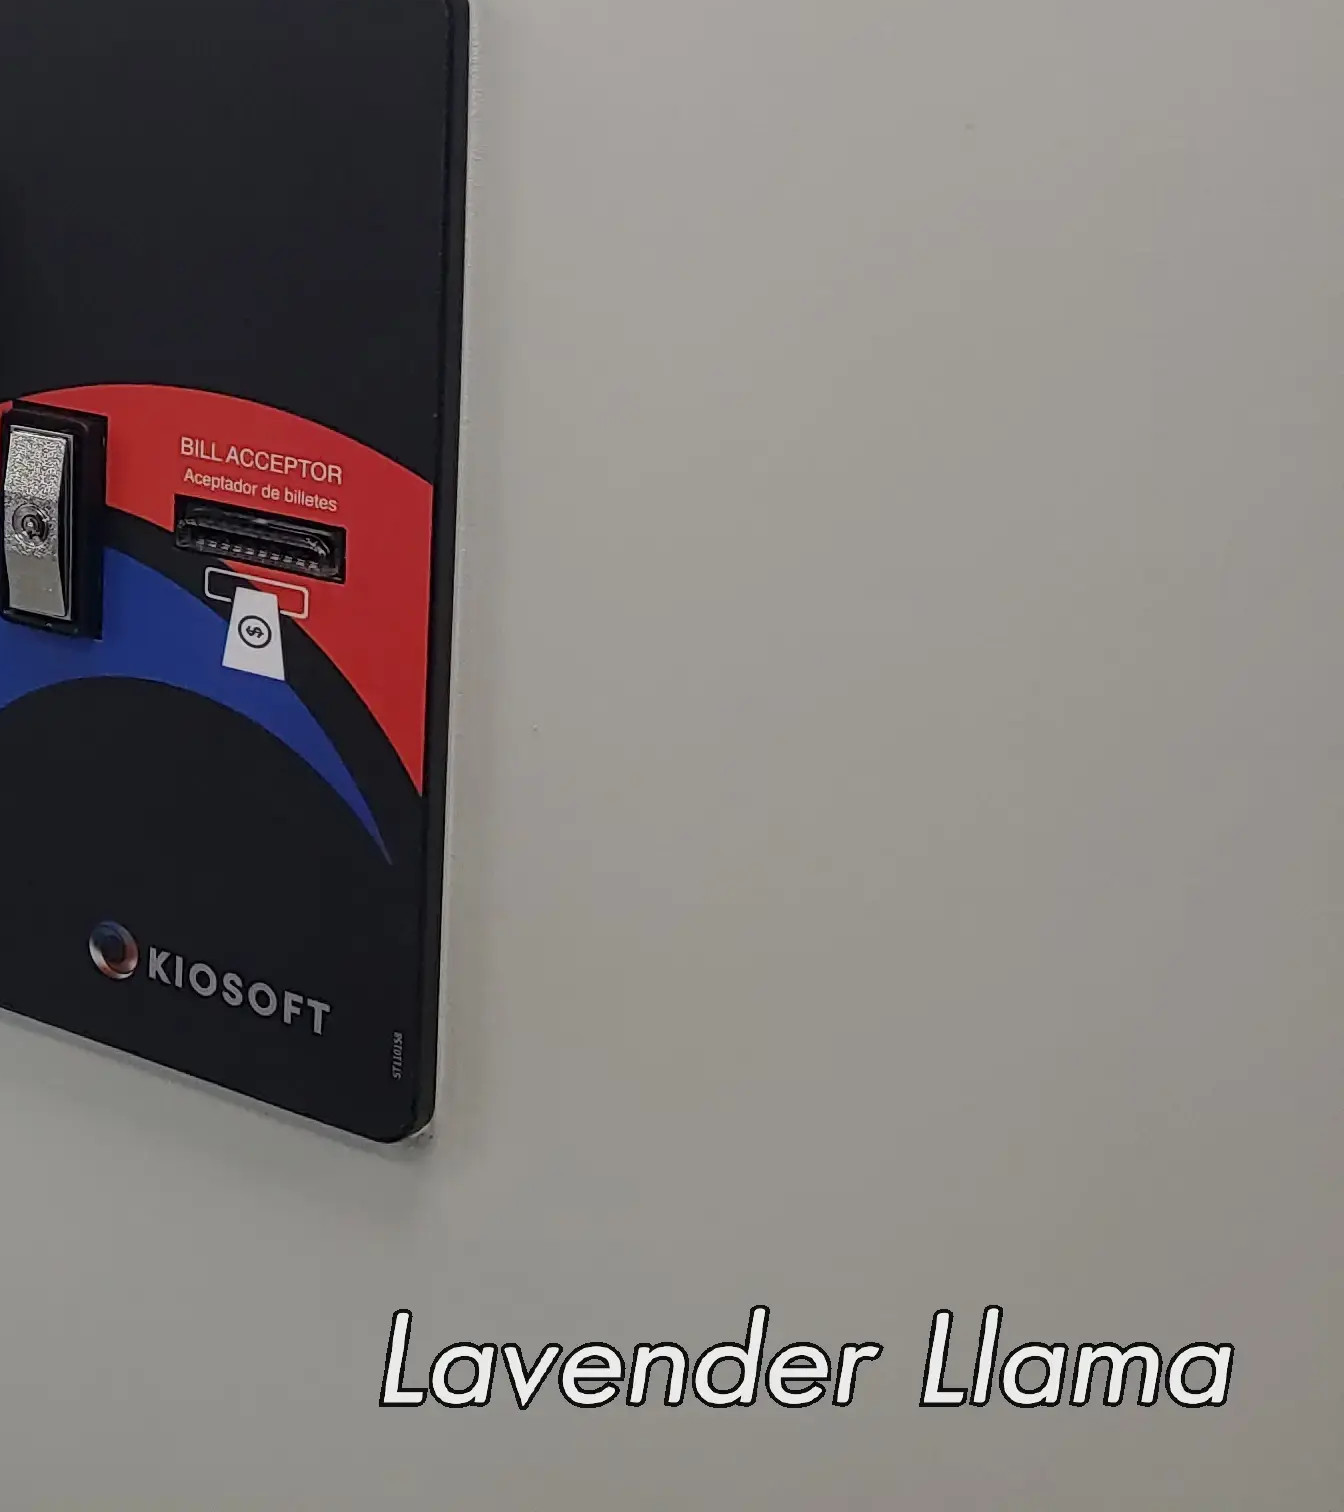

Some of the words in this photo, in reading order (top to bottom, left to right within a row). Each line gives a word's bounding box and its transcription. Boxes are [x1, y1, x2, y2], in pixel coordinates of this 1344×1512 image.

[181, 436, 221, 462] BILL
[226, 446, 343, 485] ACCEPTOR
[184, 468, 257, 497] Aceptador
[261, 482, 280, 500] de
[284, 488, 337, 512] billetes
[148, 946, 331, 1036] KIOSOFT
